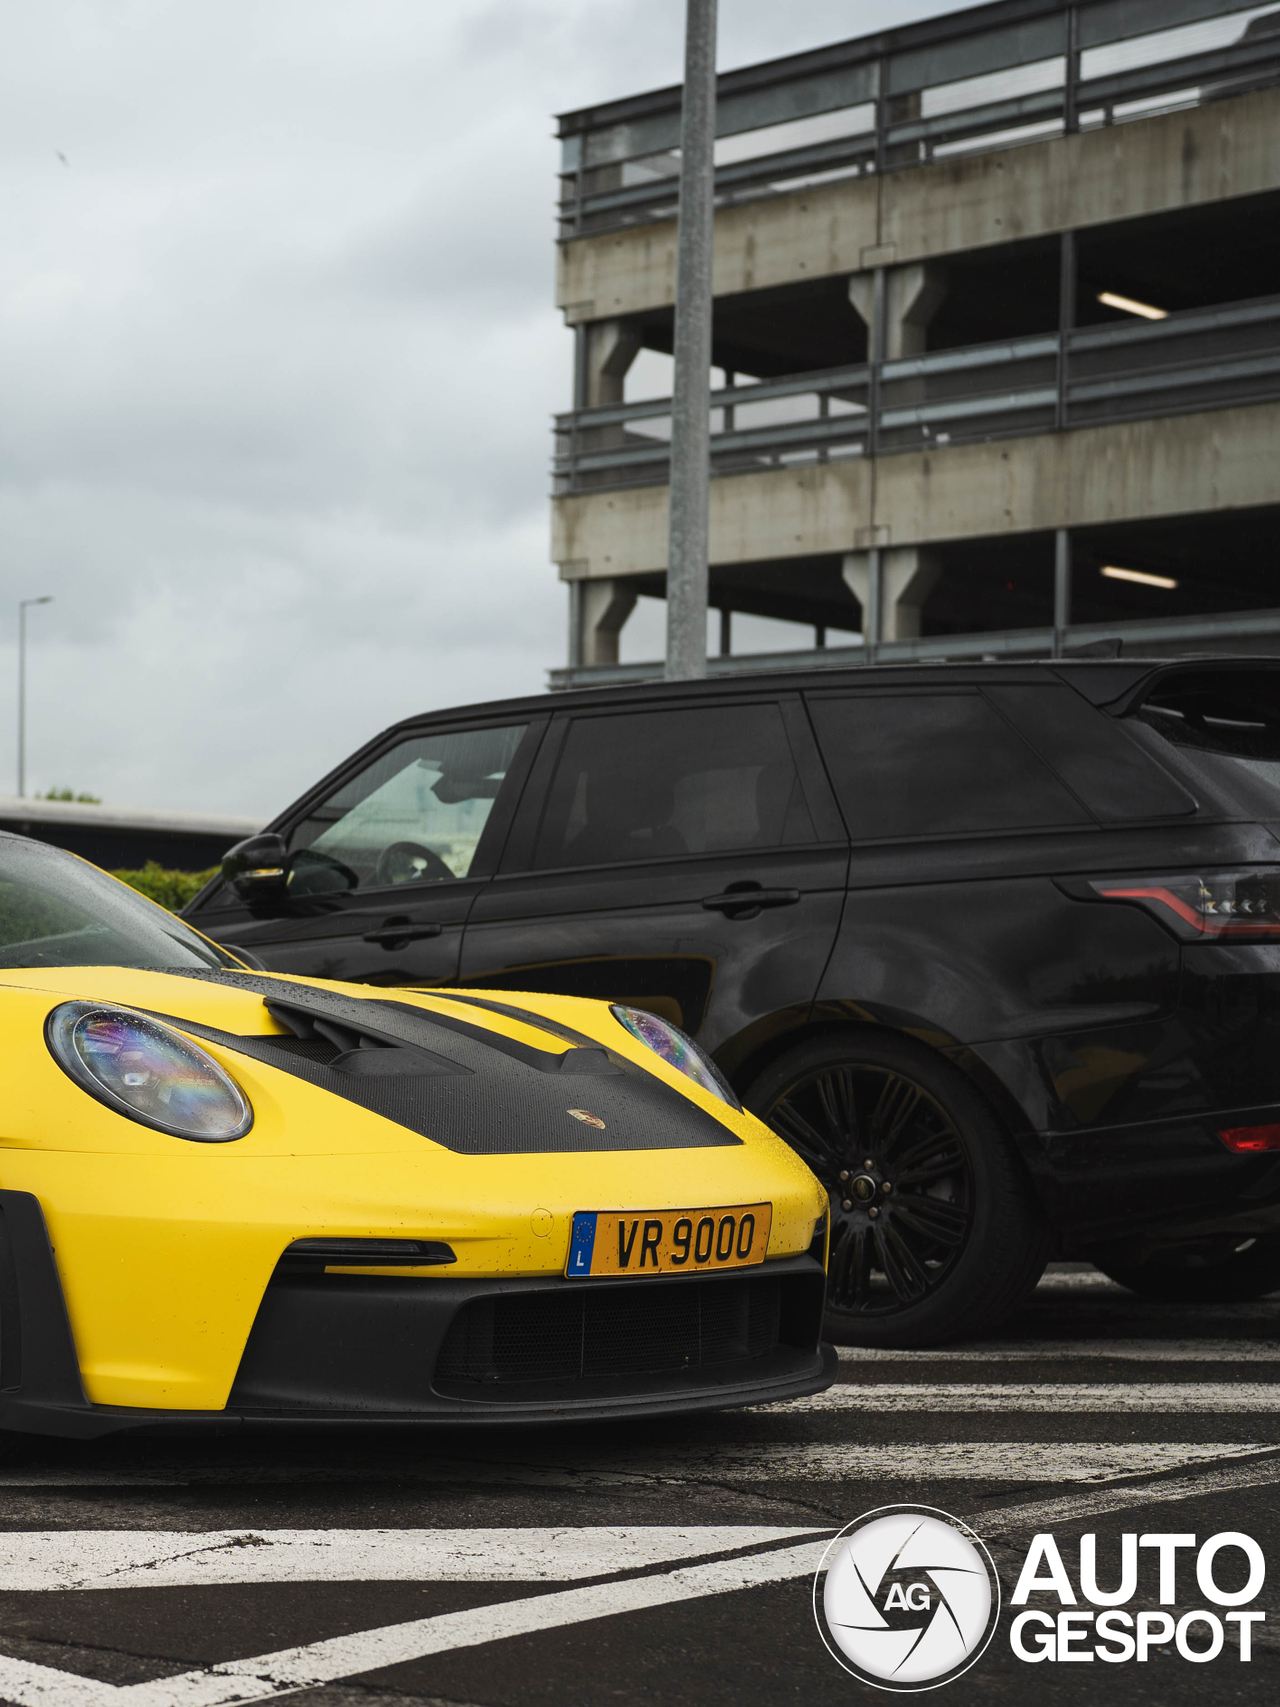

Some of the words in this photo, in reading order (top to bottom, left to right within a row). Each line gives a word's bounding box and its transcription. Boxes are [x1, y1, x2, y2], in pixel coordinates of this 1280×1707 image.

[618, 1217, 664, 1268] VR
[670, 1212, 756, 1265] 9000
[576, 1250, 585, 1267] L
